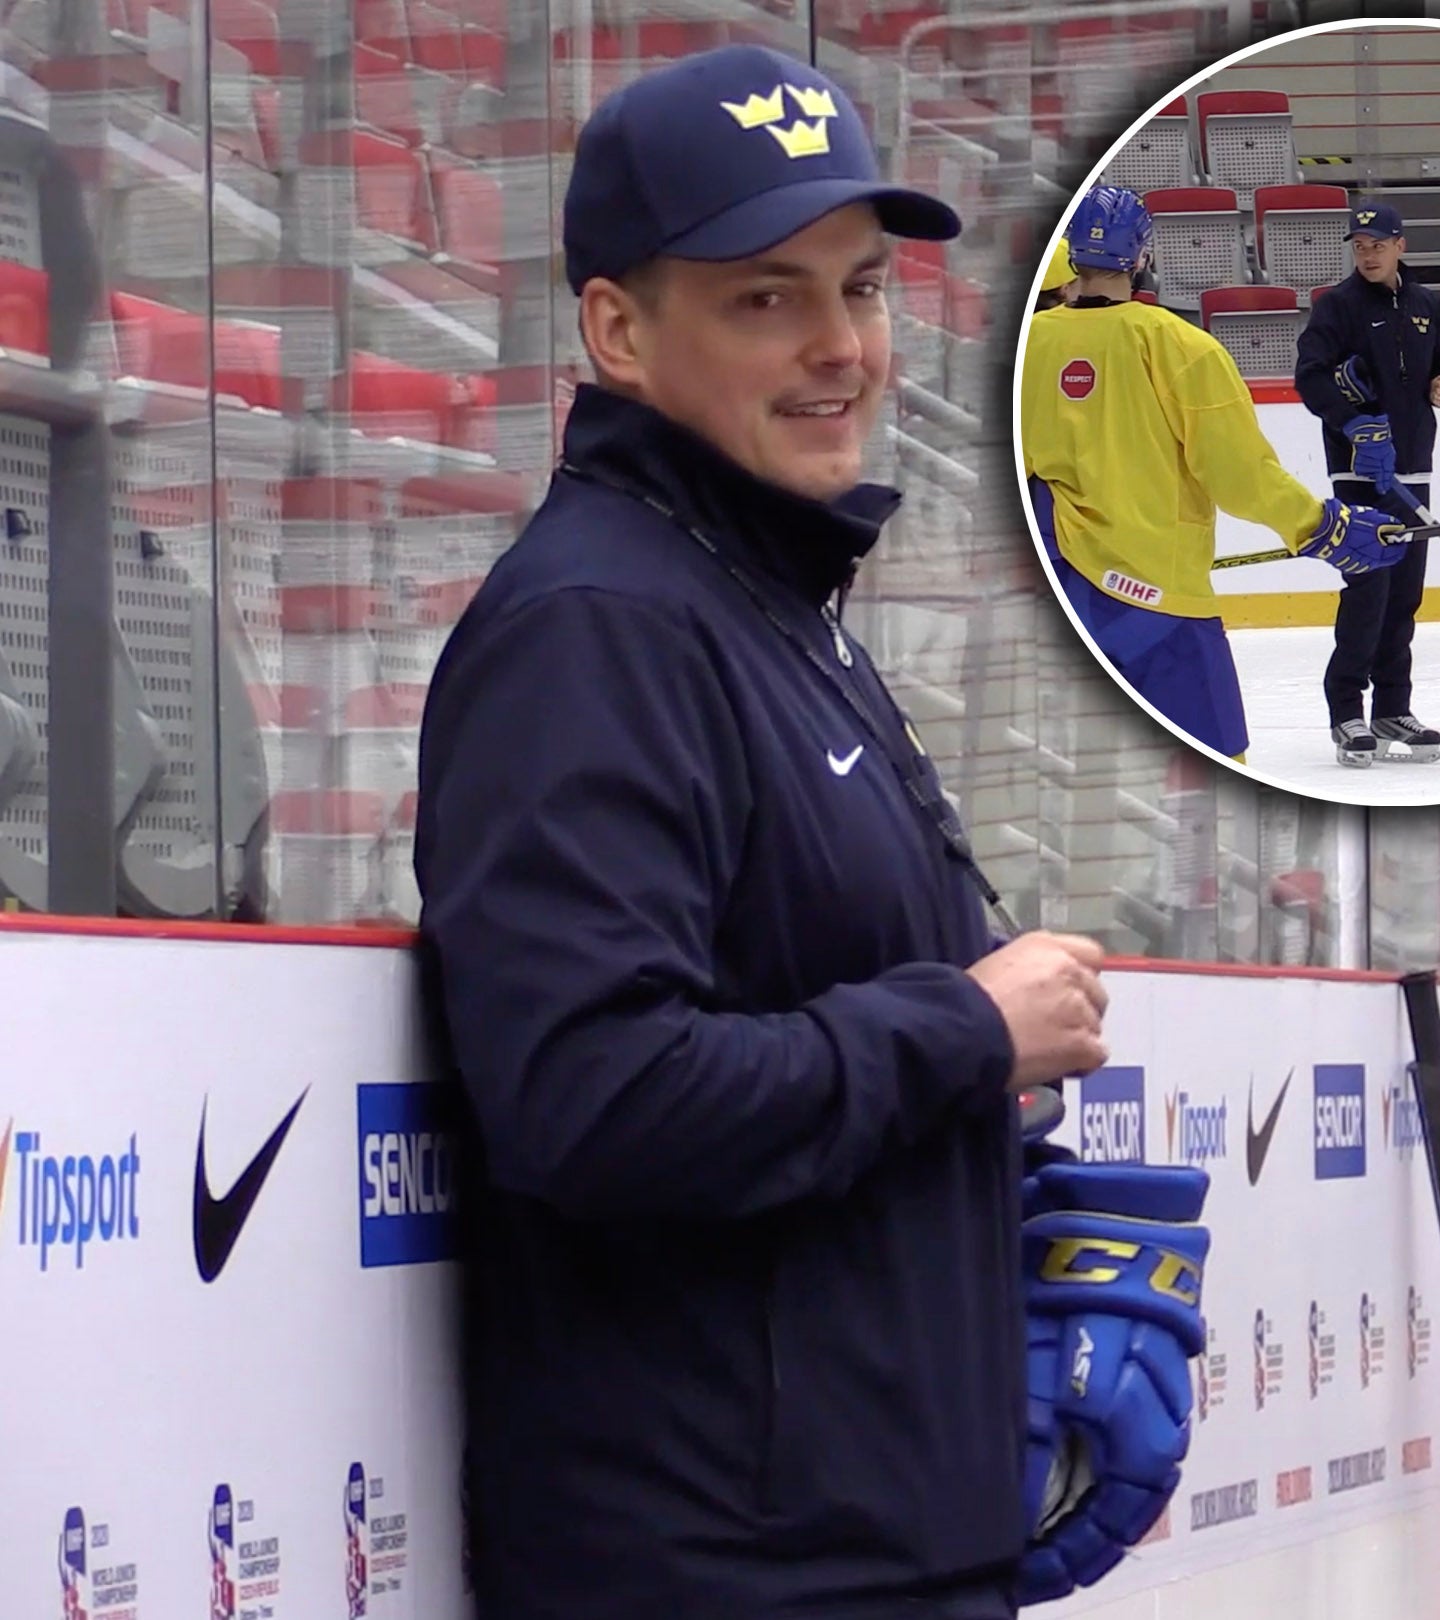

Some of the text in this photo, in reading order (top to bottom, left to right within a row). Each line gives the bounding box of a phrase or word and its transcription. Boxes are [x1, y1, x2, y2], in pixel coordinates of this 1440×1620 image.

[1117, 576, 1159, 602] IIHF
[1083, 1100, 1141, 1163] SENCOR
[1179, 1092, 1227, 1168] Tipsport
[1316, 1095, 1363, 1149] SENCOR
[15, 1130, 140, 1272] Tipsport
